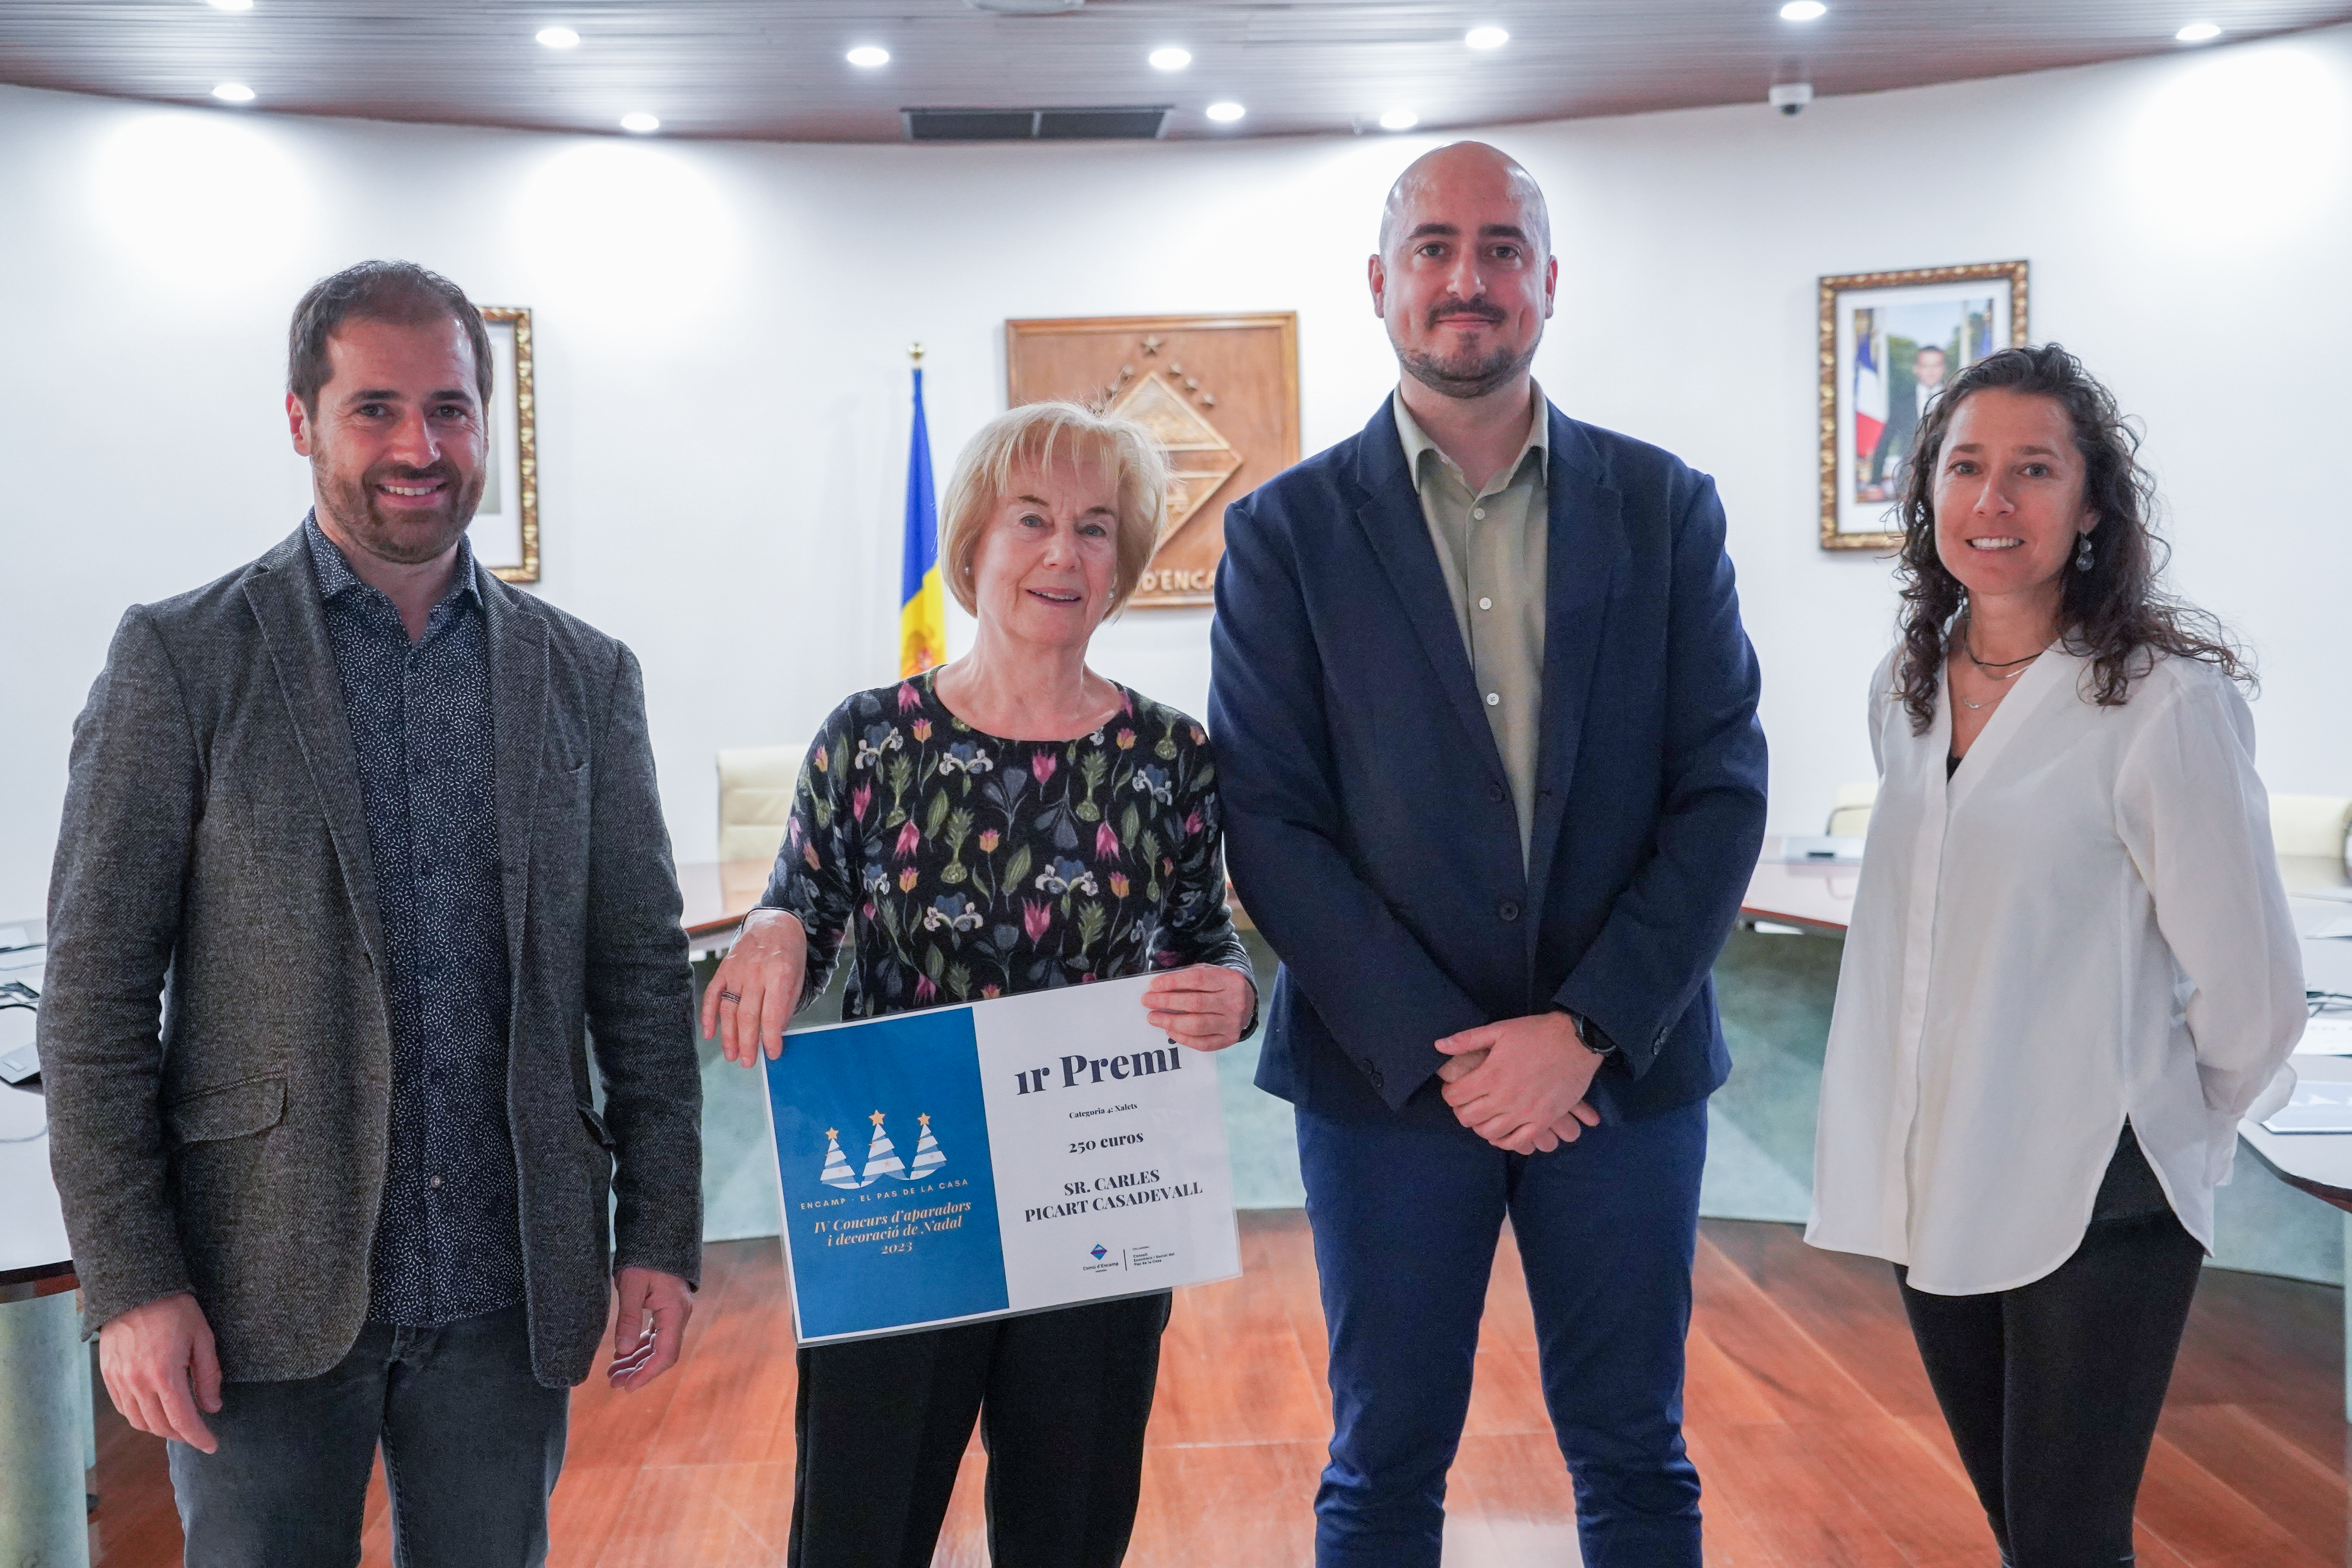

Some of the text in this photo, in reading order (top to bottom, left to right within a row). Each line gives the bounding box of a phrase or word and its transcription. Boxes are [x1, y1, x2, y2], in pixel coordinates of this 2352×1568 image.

[1014, 1038, 1182, 1095] 1r Premi
[1069, 1108, 1105, 1118] Categoria
[1114, 1103, 1138, 1112] Xalets
[1068, 1132, 1143, 1154] 250 euros
[801, 1198, 846, 1210] ENCAMP
[877, 1191, 897, 1200] PAS
[939, 1179, 968, 1189] CASA
[1064, 1169, 1160, 1196] SR. CARLES
[1025, 1181, 1203, 1222] PICART CASADEVALL
[815, 1201, 971, 1234] IV Concurs d'aparadors
[828, 1216, 962, 1246] i decoració de Nadal
[882, 1242, 913, 1254] 2023
